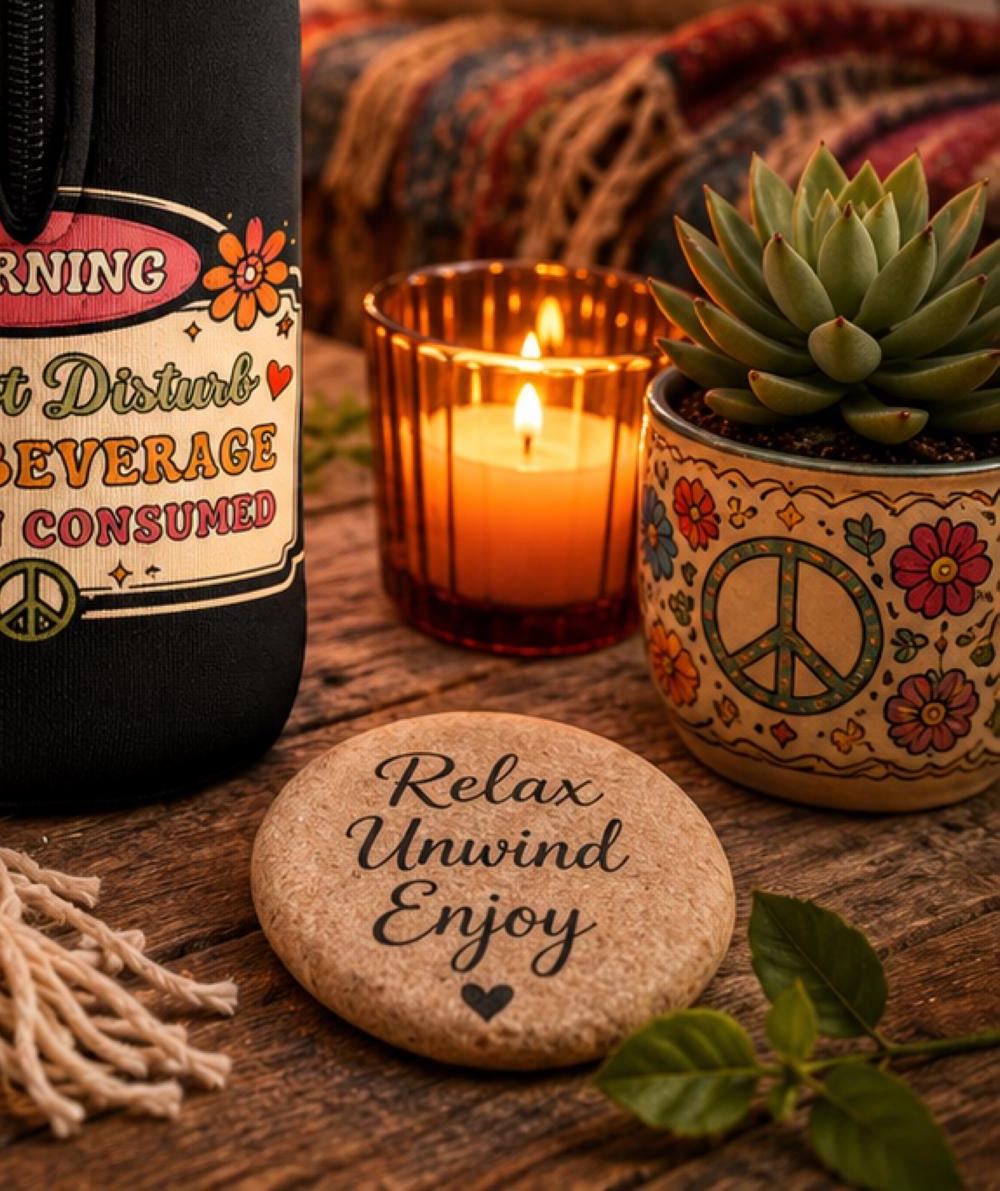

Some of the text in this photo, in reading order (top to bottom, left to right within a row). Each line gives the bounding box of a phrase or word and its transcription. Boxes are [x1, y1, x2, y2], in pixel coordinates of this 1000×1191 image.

[43, 351, 260, 418] Disturb
[22, 489, 277, 548] CONSUMED
[375, 751, 604, 809] Relax
[346, 815, 630, 872] Unwind
[372, 879, 597, 977] Enjoy
